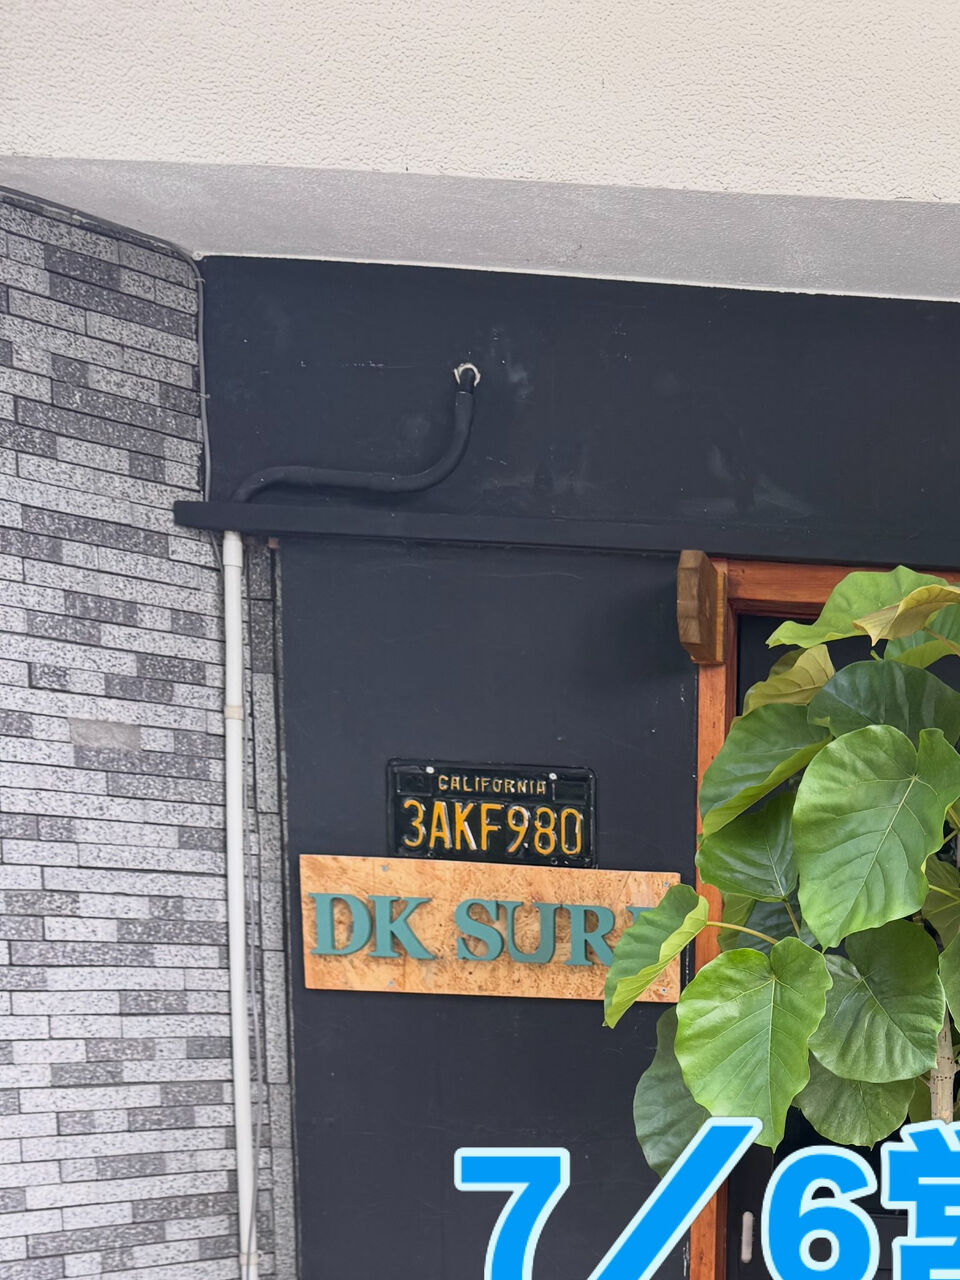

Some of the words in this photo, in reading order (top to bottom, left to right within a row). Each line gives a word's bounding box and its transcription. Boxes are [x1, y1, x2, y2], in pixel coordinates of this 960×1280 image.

[438, 774, 546, 795] CALIFORNIA
[403, 799, 584, 855] 3AKF980
[308, 893, 435, 960] DK
[454, 898, 656, 967] SUR
